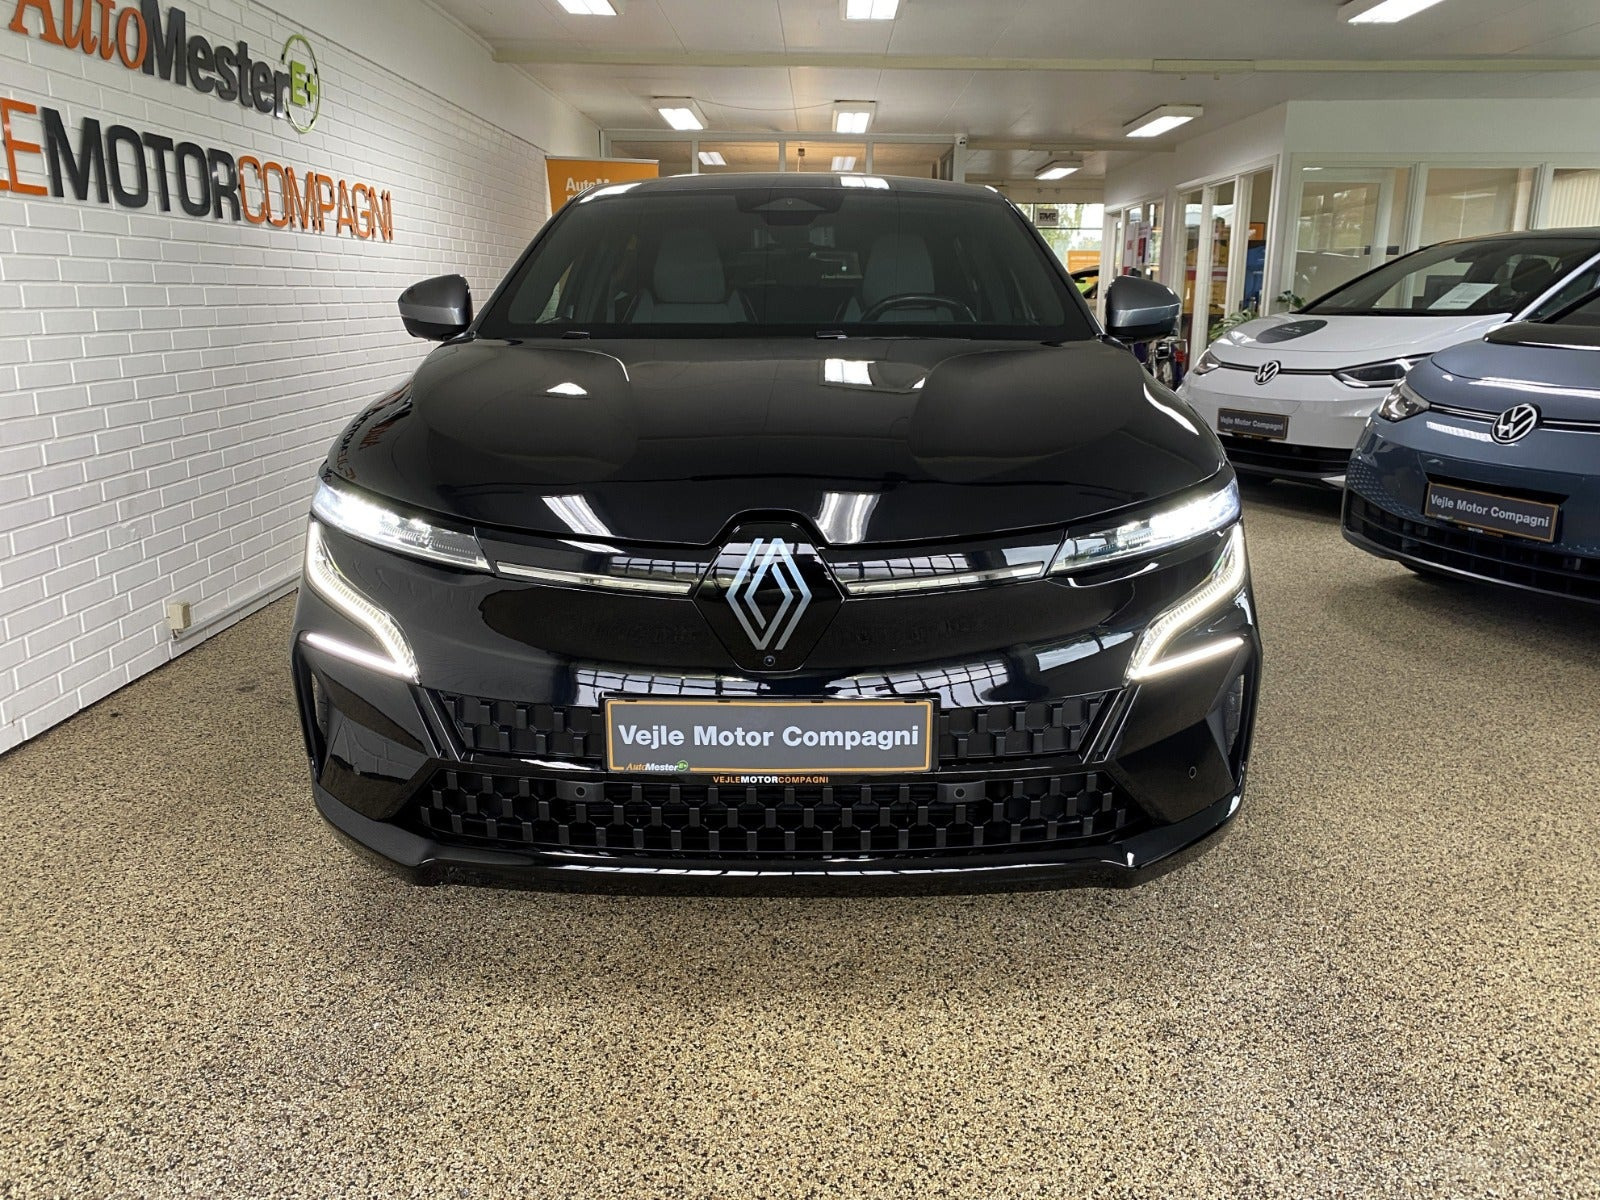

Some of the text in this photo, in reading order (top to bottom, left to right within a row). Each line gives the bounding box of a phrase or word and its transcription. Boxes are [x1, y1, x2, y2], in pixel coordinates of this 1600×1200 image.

[0, 97, 393, 241] EMOTORCOMPAGNI
[1431, 494, 1550, 528] Vejle Motor Compagni
[618, 724, 919, 750] Vejle Motor Compagni
[713, 776, 829, 784] VEJLEMOTORCOMPAGNI
